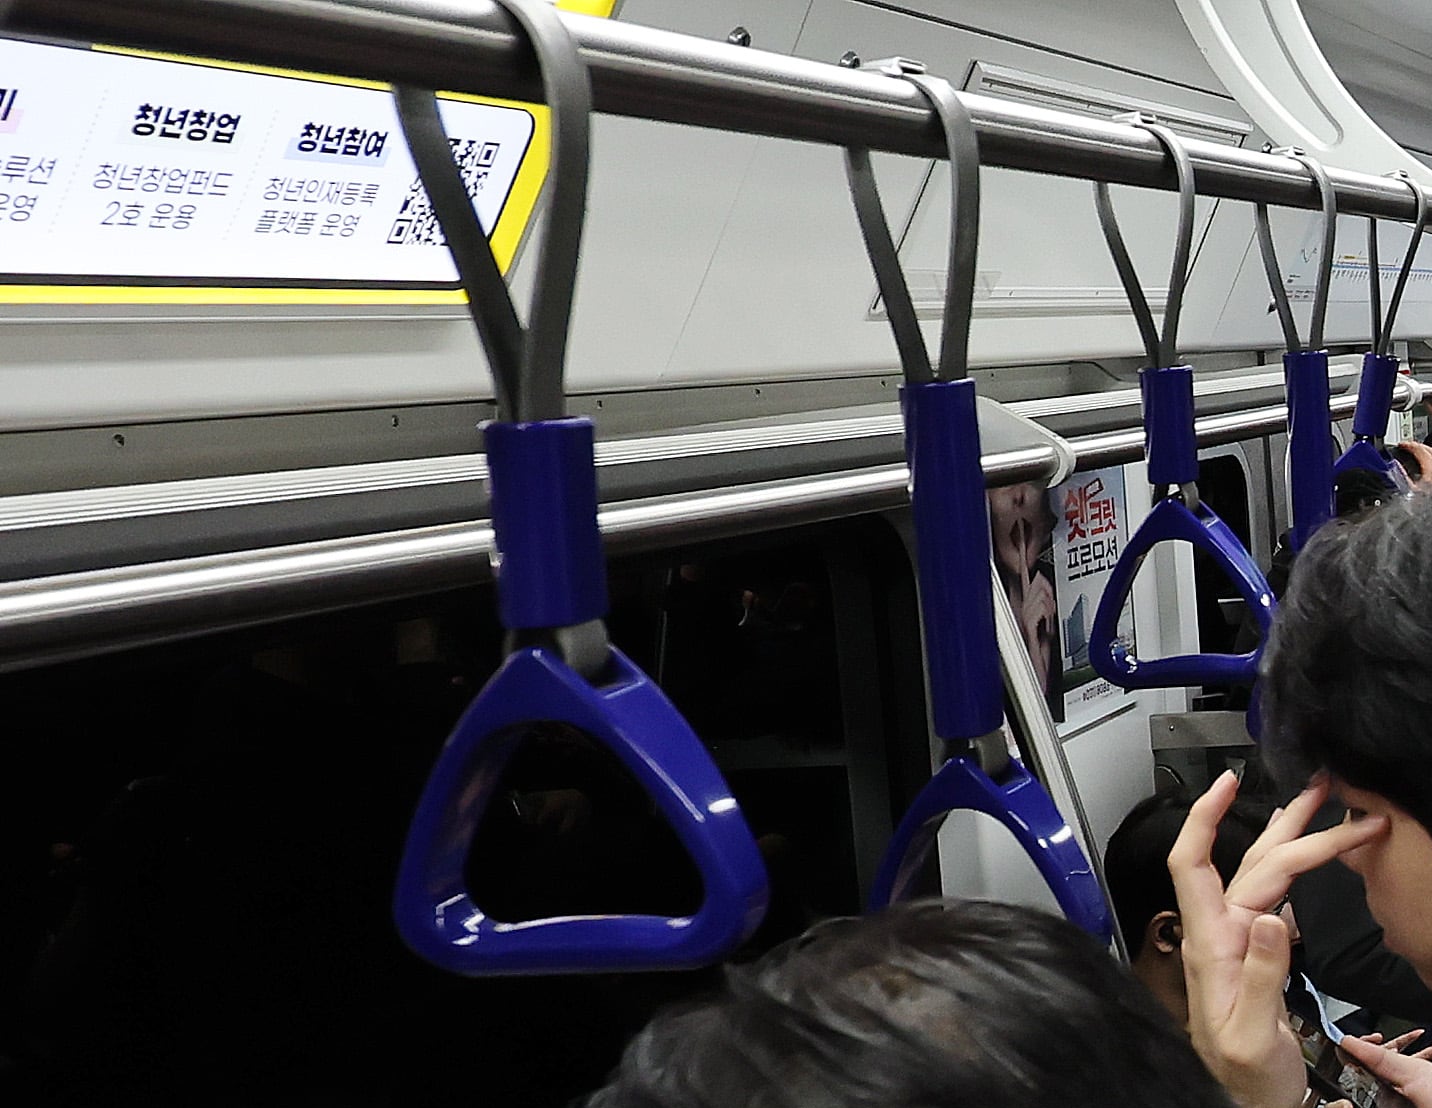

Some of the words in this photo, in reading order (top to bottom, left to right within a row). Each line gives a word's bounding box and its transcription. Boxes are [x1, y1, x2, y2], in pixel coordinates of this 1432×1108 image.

[133, 103, 241, 144] 청년창업
[297, 121, 388, 158] 청년참여
[0, 155, 57, 185] 루션
[93, 161, 234, 196] 청년창업펀드
[263, 176, 380, 208] 청년인재등록
[100, 200, 144, 227] 2호
[149, 203, 197, 230] 운용
[254, 209, 318, 236] 플랫폼
[320, 213, 361, 238] 운영
[1066, 536, 1118, 582] 프로모션
